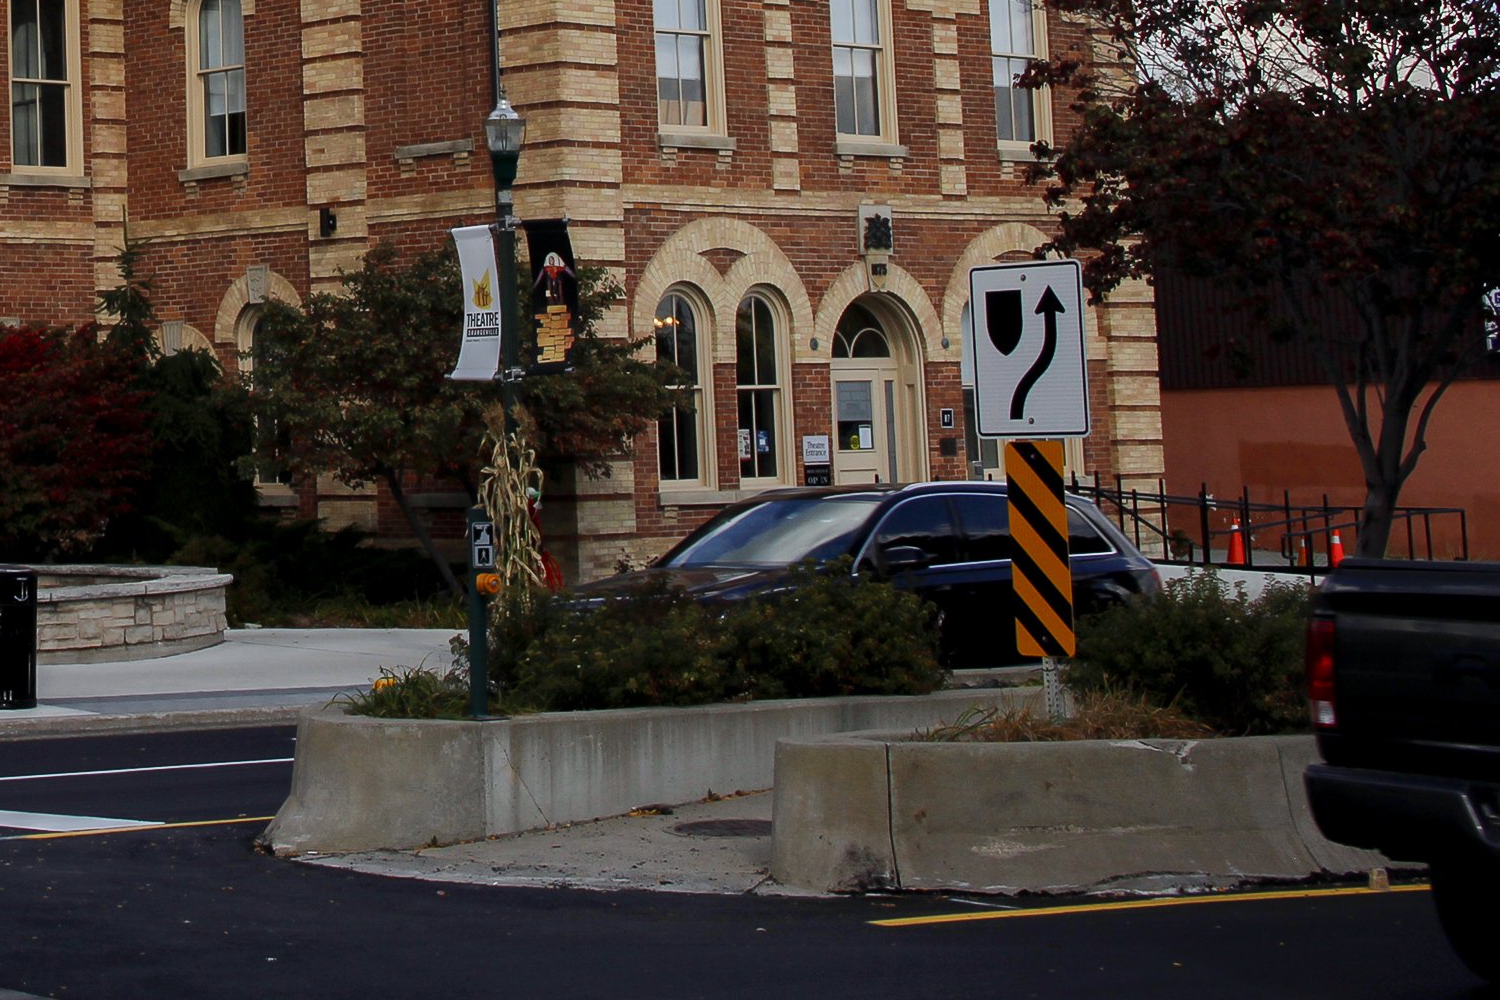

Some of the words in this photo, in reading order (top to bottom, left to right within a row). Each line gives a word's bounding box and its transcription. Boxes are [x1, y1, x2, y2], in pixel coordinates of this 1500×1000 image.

[467, 312, 499, 327] THEATRE
[807, 441, 826, 449] Theatre
[805, 449, 827, 457] Entrance
